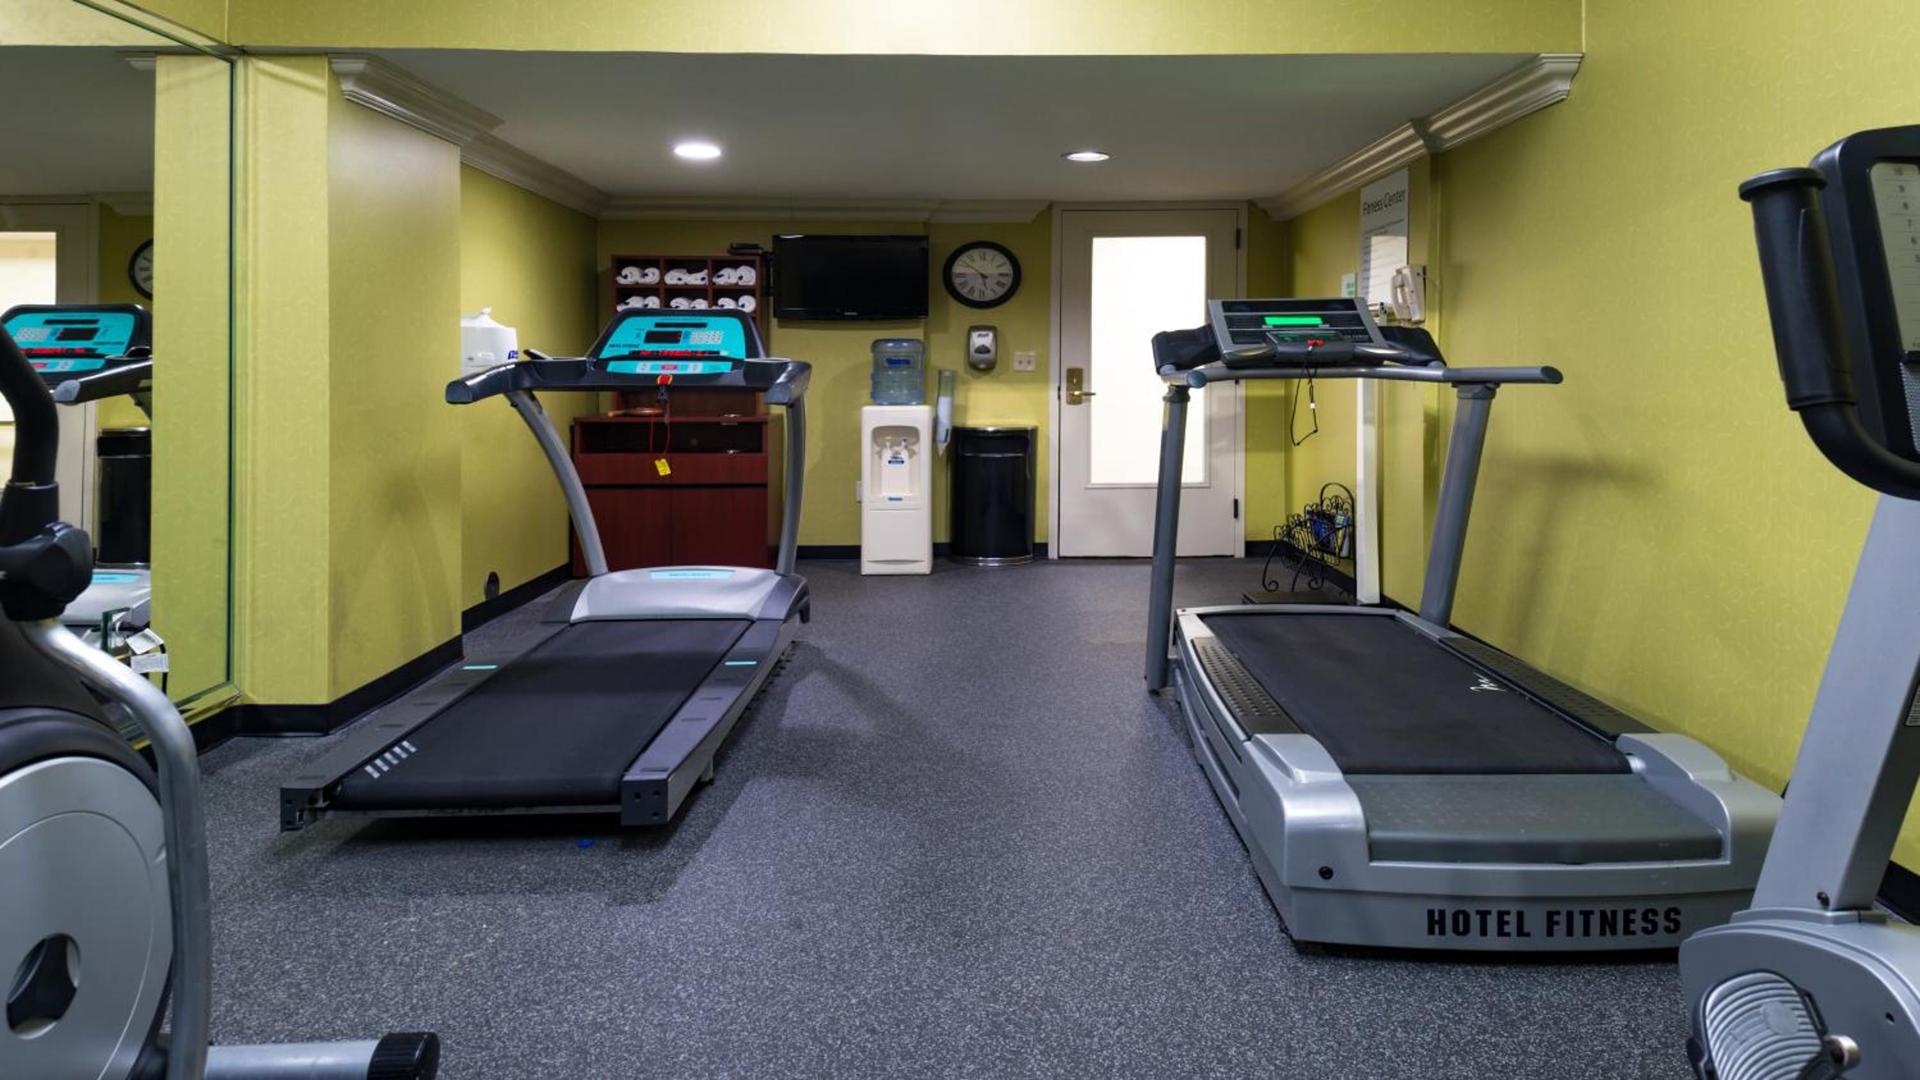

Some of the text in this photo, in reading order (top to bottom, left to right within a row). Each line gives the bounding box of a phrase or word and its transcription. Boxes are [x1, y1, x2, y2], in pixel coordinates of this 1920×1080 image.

[1363, 189, 1406, 215] Fitness Center
[1427, 907, 1682, 938] HOTEL FITNESS
